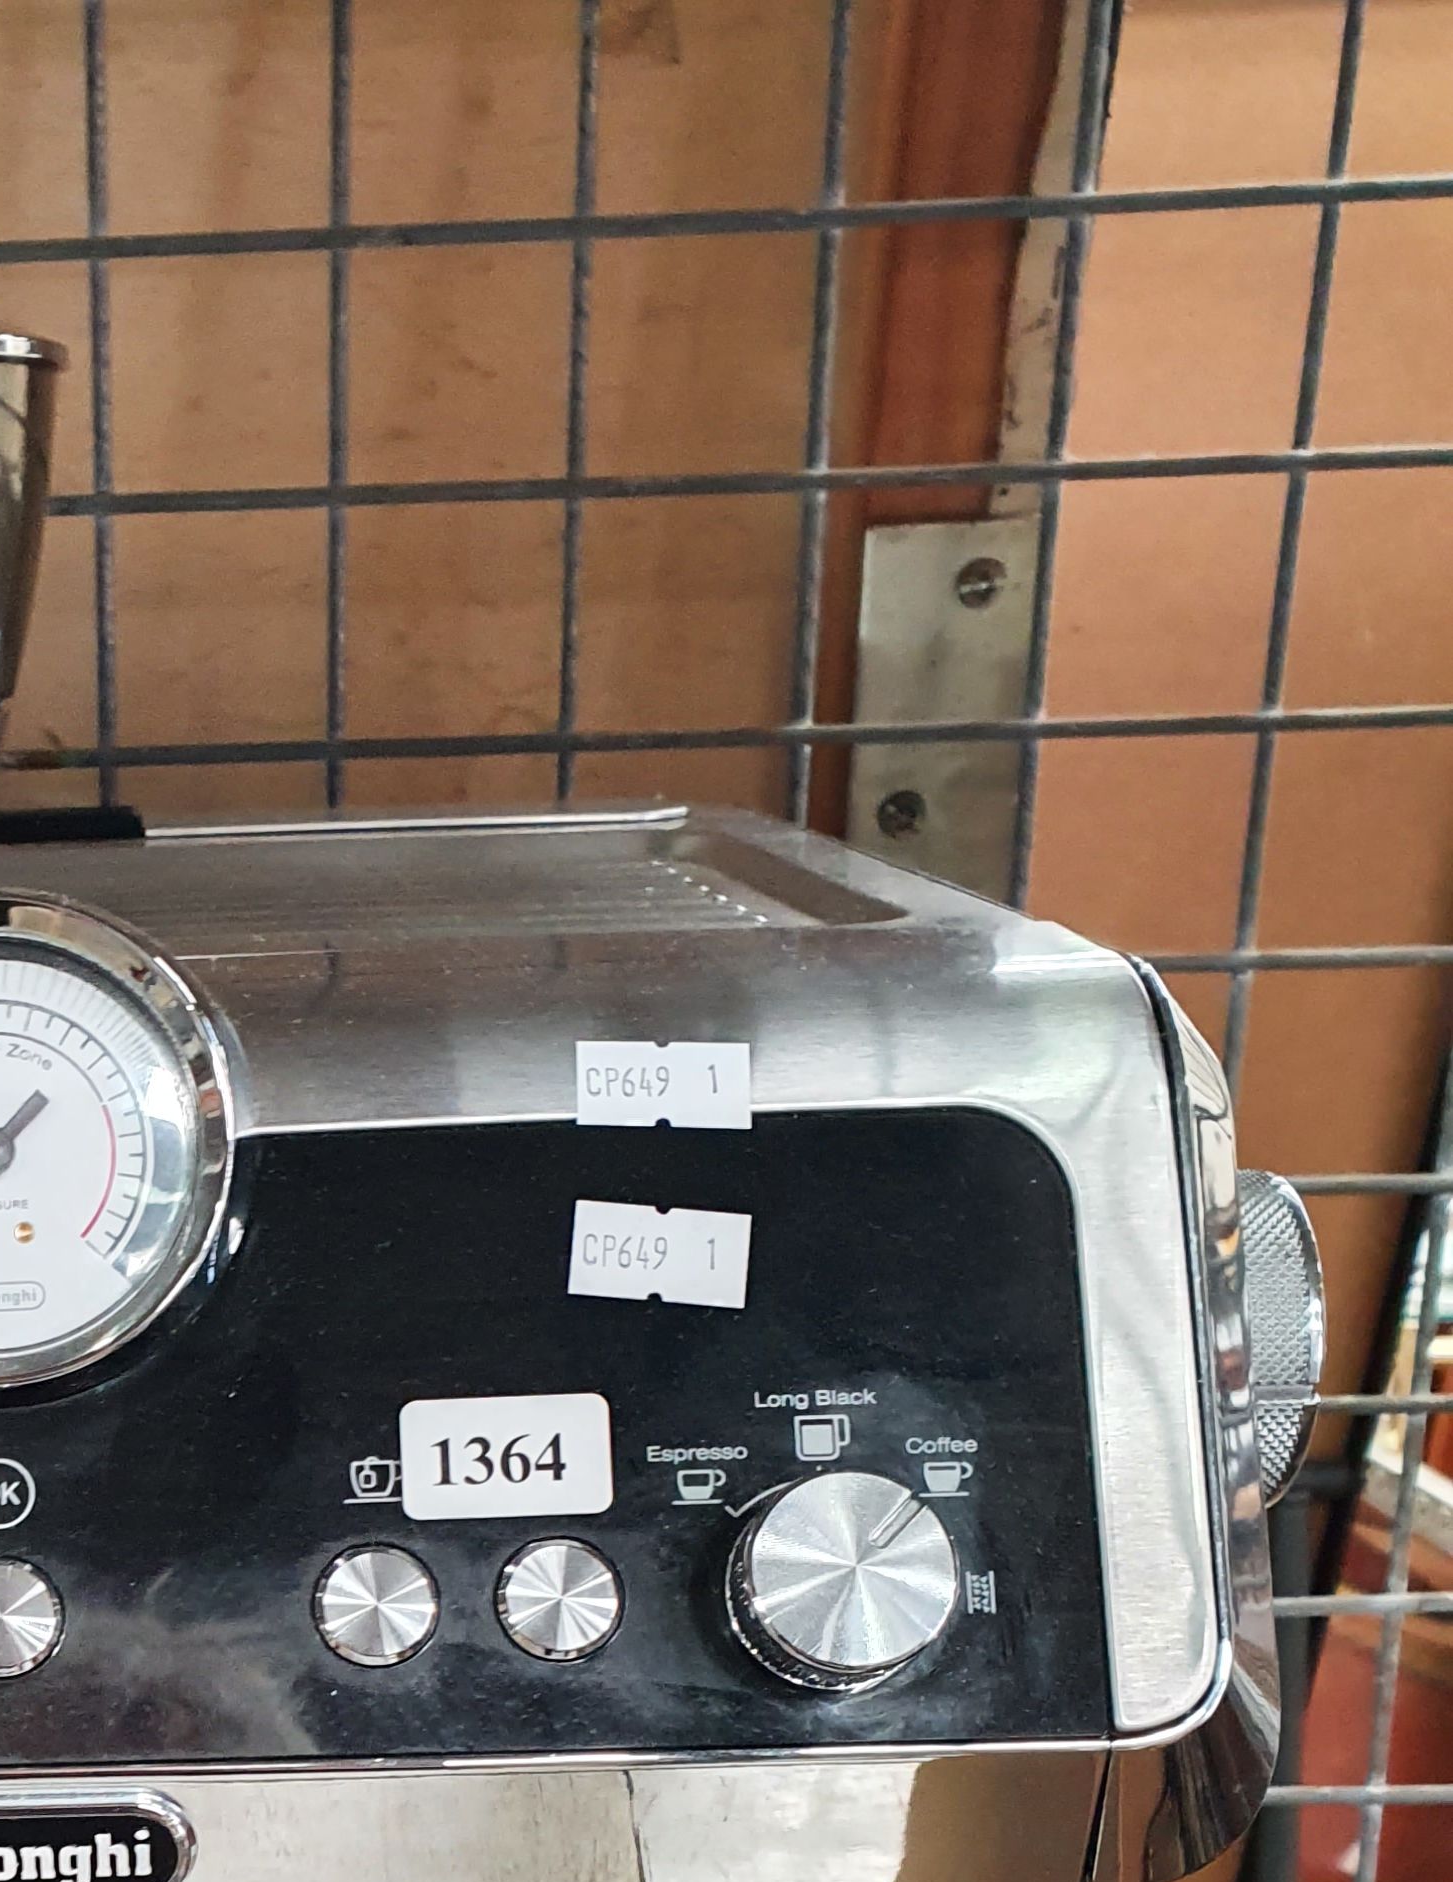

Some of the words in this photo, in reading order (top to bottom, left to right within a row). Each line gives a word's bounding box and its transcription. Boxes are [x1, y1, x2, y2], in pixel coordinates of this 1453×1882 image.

[6, 1043, 53, 1071] Zone
[586, 1065, 670, 1098] CP649
[707, 1063, 718, 1095] 1
[583, 1233, 668, 1270] CP649
[707, 1237, 716, 1271] 1
[753, 1390, 809, 1410] Long
[814, 1388, 878, 1407] Black
[429, 1432, 567, 1487] 1364
[646, 1445, 748, 1465] Espresso
[904, 1437, 979, 1455] Coffee
